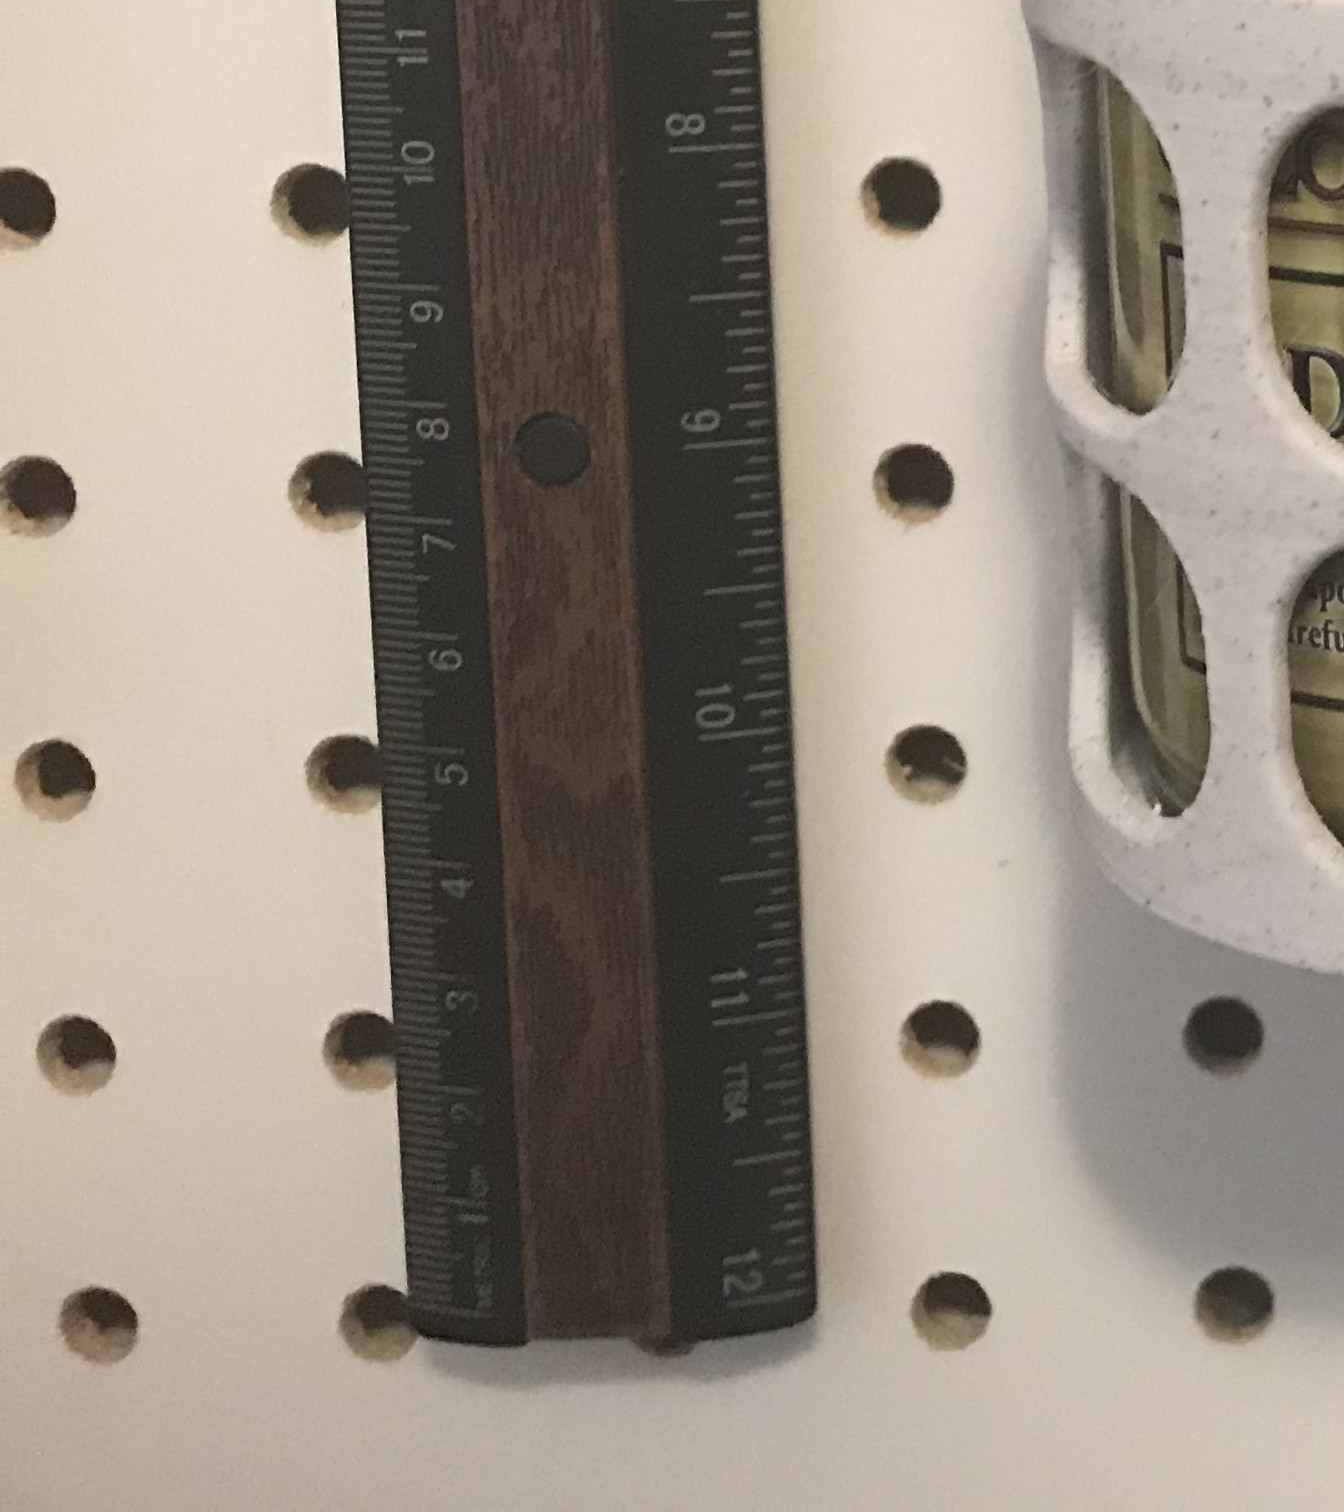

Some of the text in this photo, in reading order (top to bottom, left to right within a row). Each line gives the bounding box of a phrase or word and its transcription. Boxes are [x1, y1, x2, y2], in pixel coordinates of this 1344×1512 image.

[665, 112, 706, 137] 8
[401, 140, 437, 185] 10
[416, 416, 450, 442] 8
[421, 534, 458, 555] 7
[696, 683, 736, 730] 10
[435, 762, 469, 787] 5
[709, 966, 751, 1009] 11
[722, 1248, 764, 1298] 12
